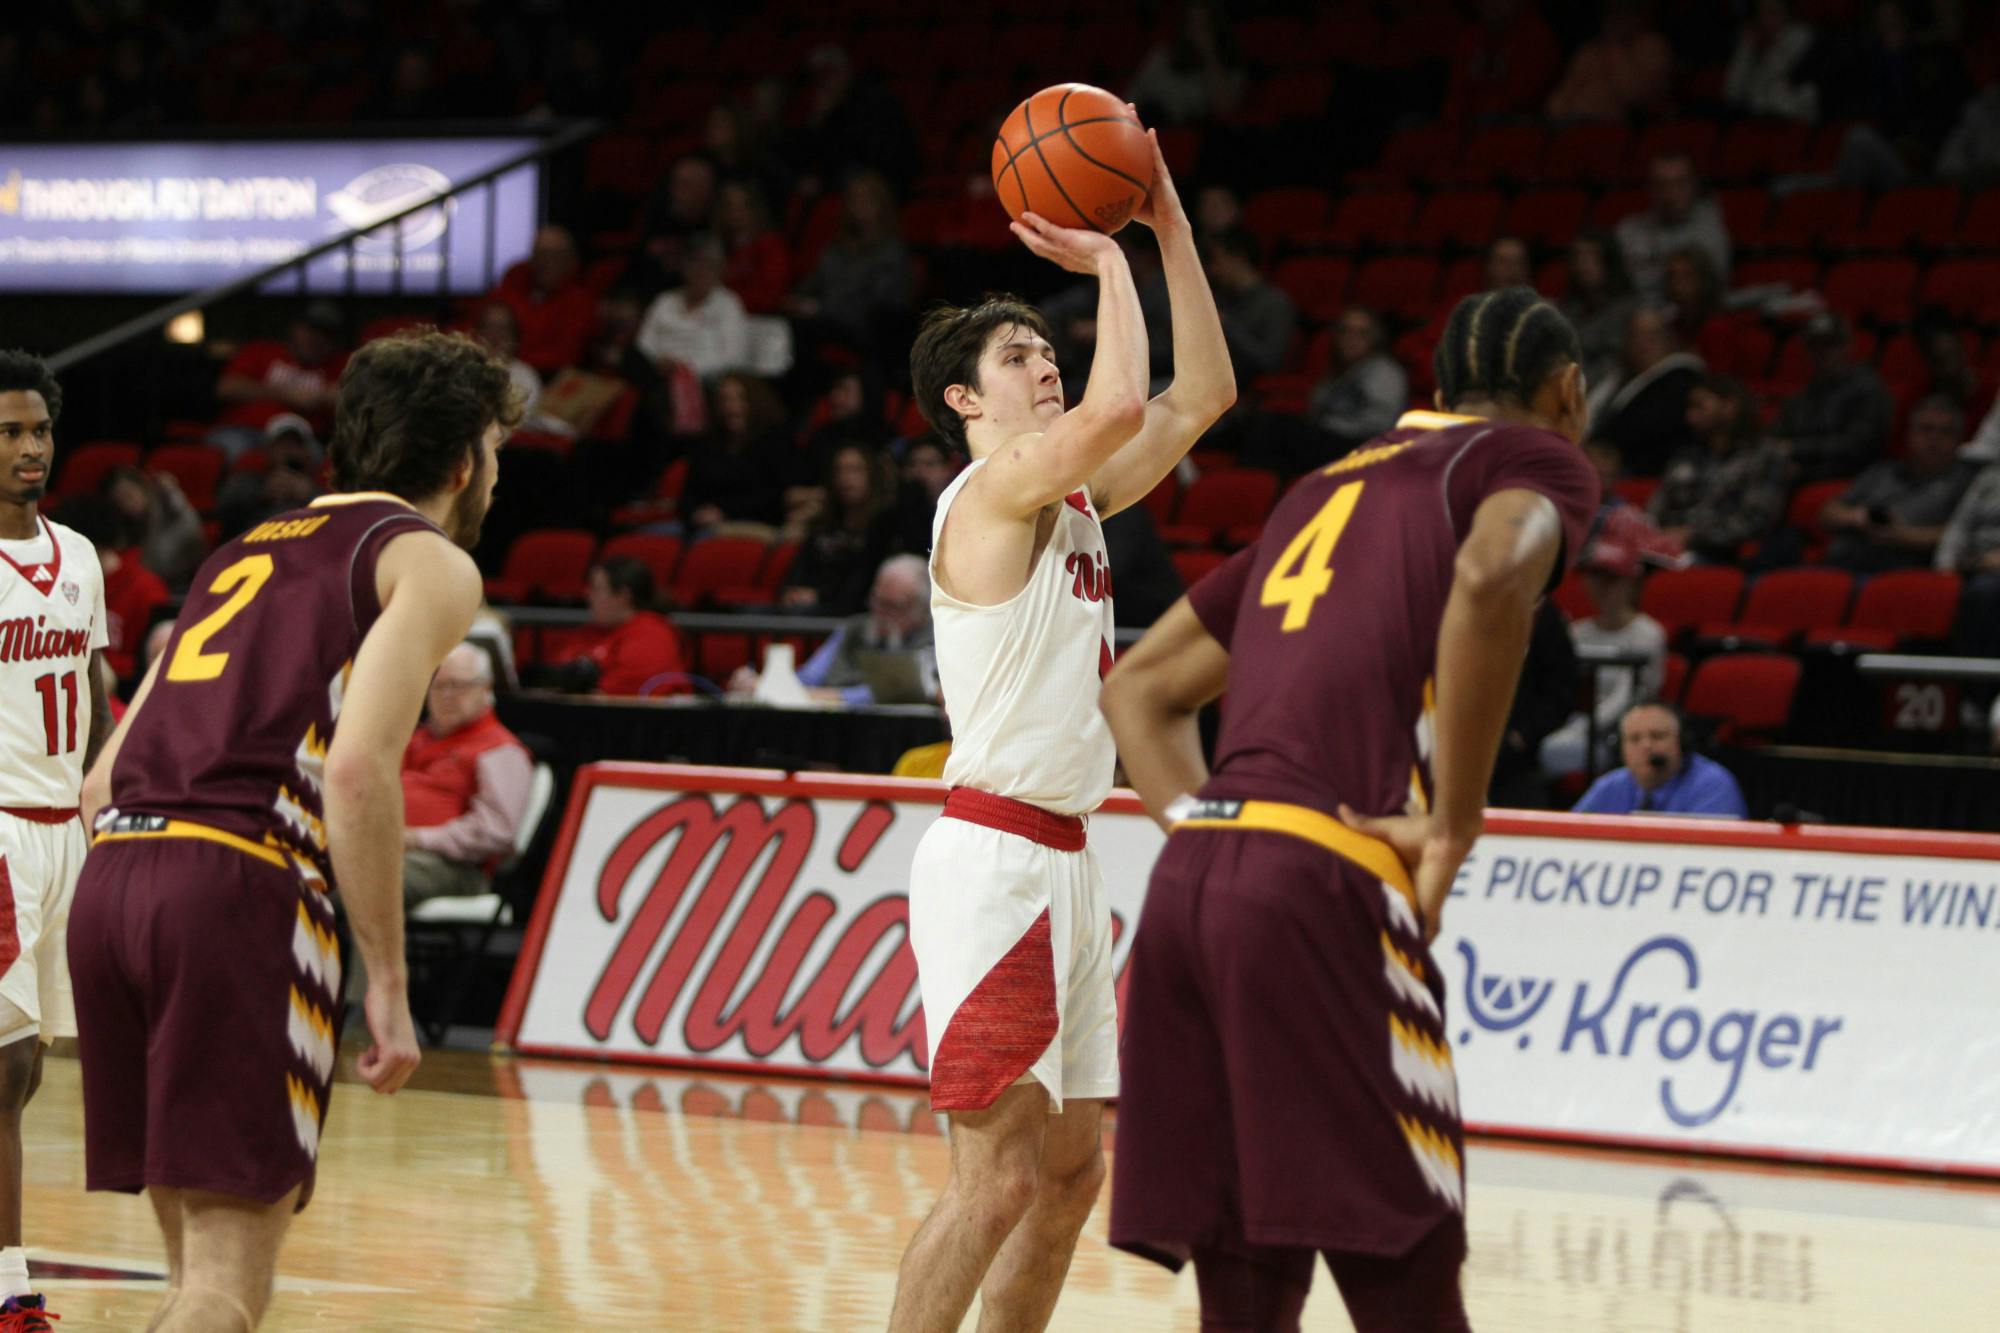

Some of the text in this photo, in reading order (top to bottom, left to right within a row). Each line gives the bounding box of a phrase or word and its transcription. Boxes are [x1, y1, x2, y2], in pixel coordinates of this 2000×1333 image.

[203, 177, 317, 220] DAYTON
[1260, 480, 1365, 633] 4
[166, 553, 274, 682] 2
[35, 670, 78, 756] 11
[1894, 684, 1945, 730] 20
[1485, 857, 1663, 908] PICKUP
[1671, 867, 1775, 915] FOR
[1791, 874, 1887, 922] THE
[1902, 878, 2000, 929] WIN
[1560, 935, 1843, 1127] Kroger
